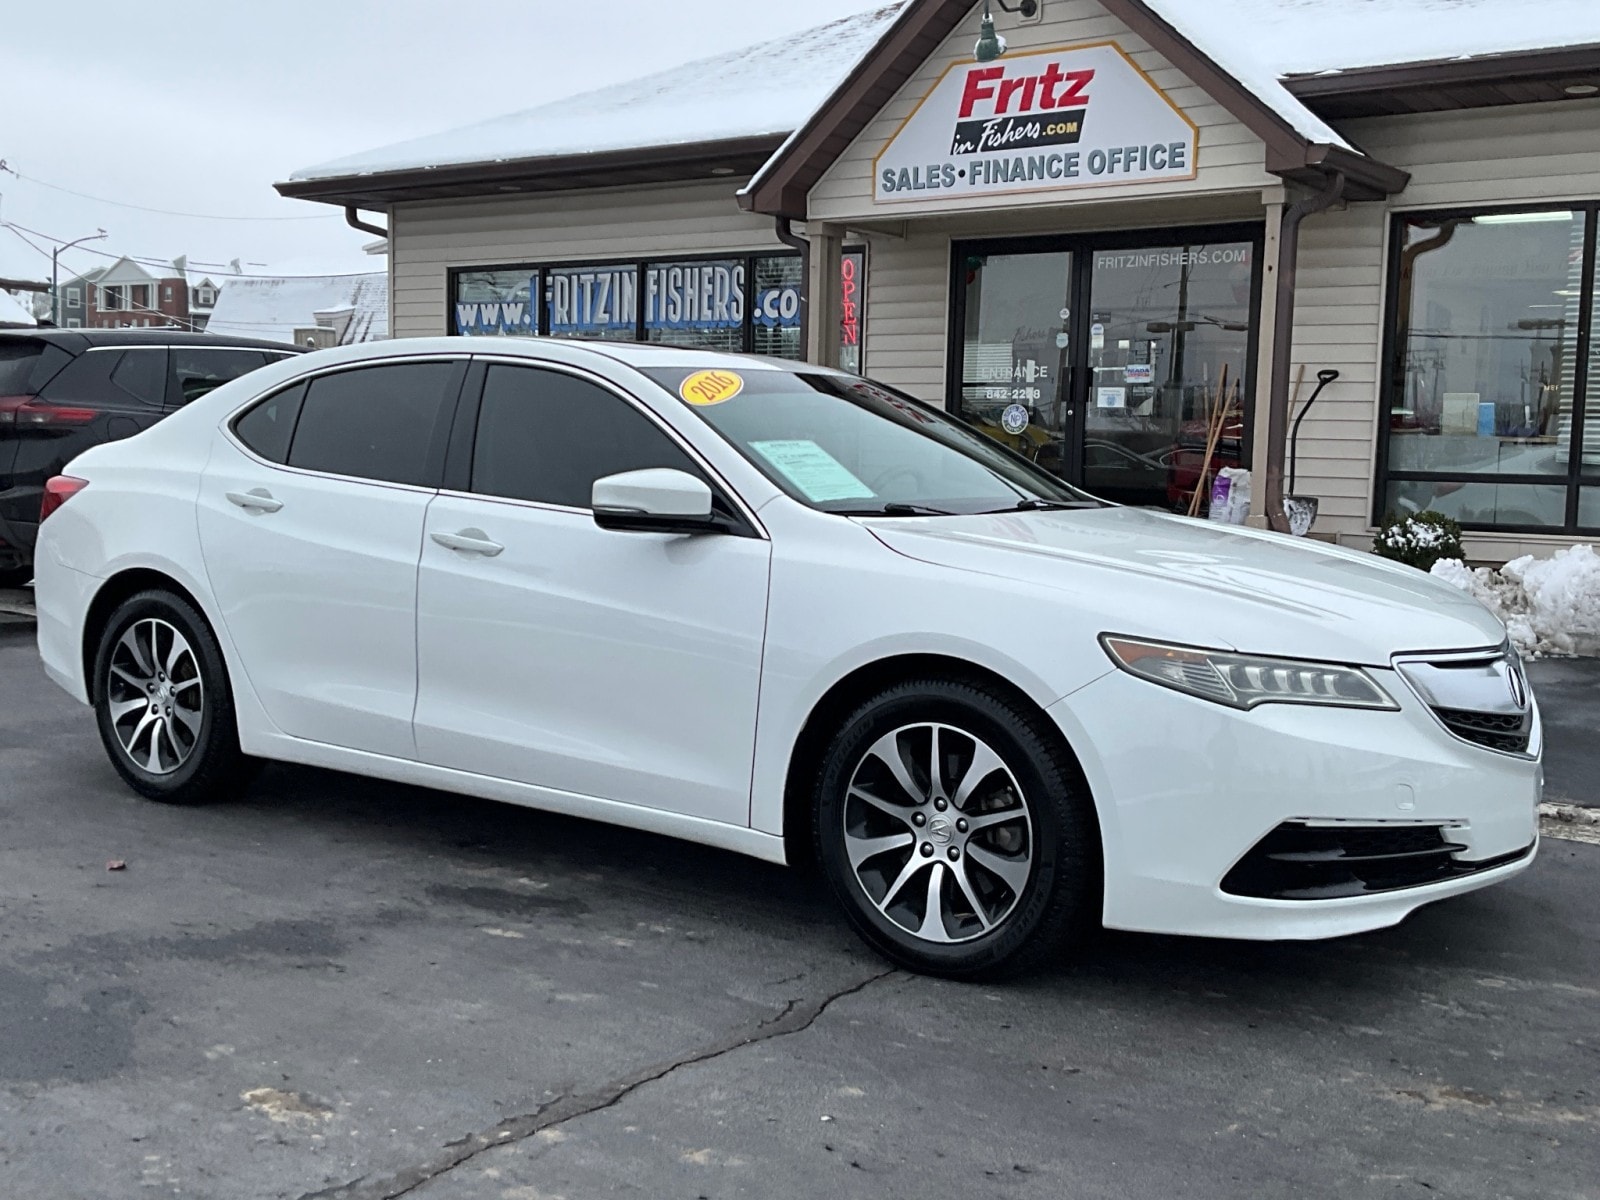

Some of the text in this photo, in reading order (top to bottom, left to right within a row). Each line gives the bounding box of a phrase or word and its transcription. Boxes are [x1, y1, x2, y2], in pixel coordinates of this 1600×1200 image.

[958, 63, 1095, 118] Fritz
[953, 133, 975, 155] in
[1087, 142, 1186, 175] OFFICE
[1097, 249, 1247, 269] FRITZINFISHERS.COM
[842, 258, 858, 346] OPEN
[690, 371, 735, 401] 2016
